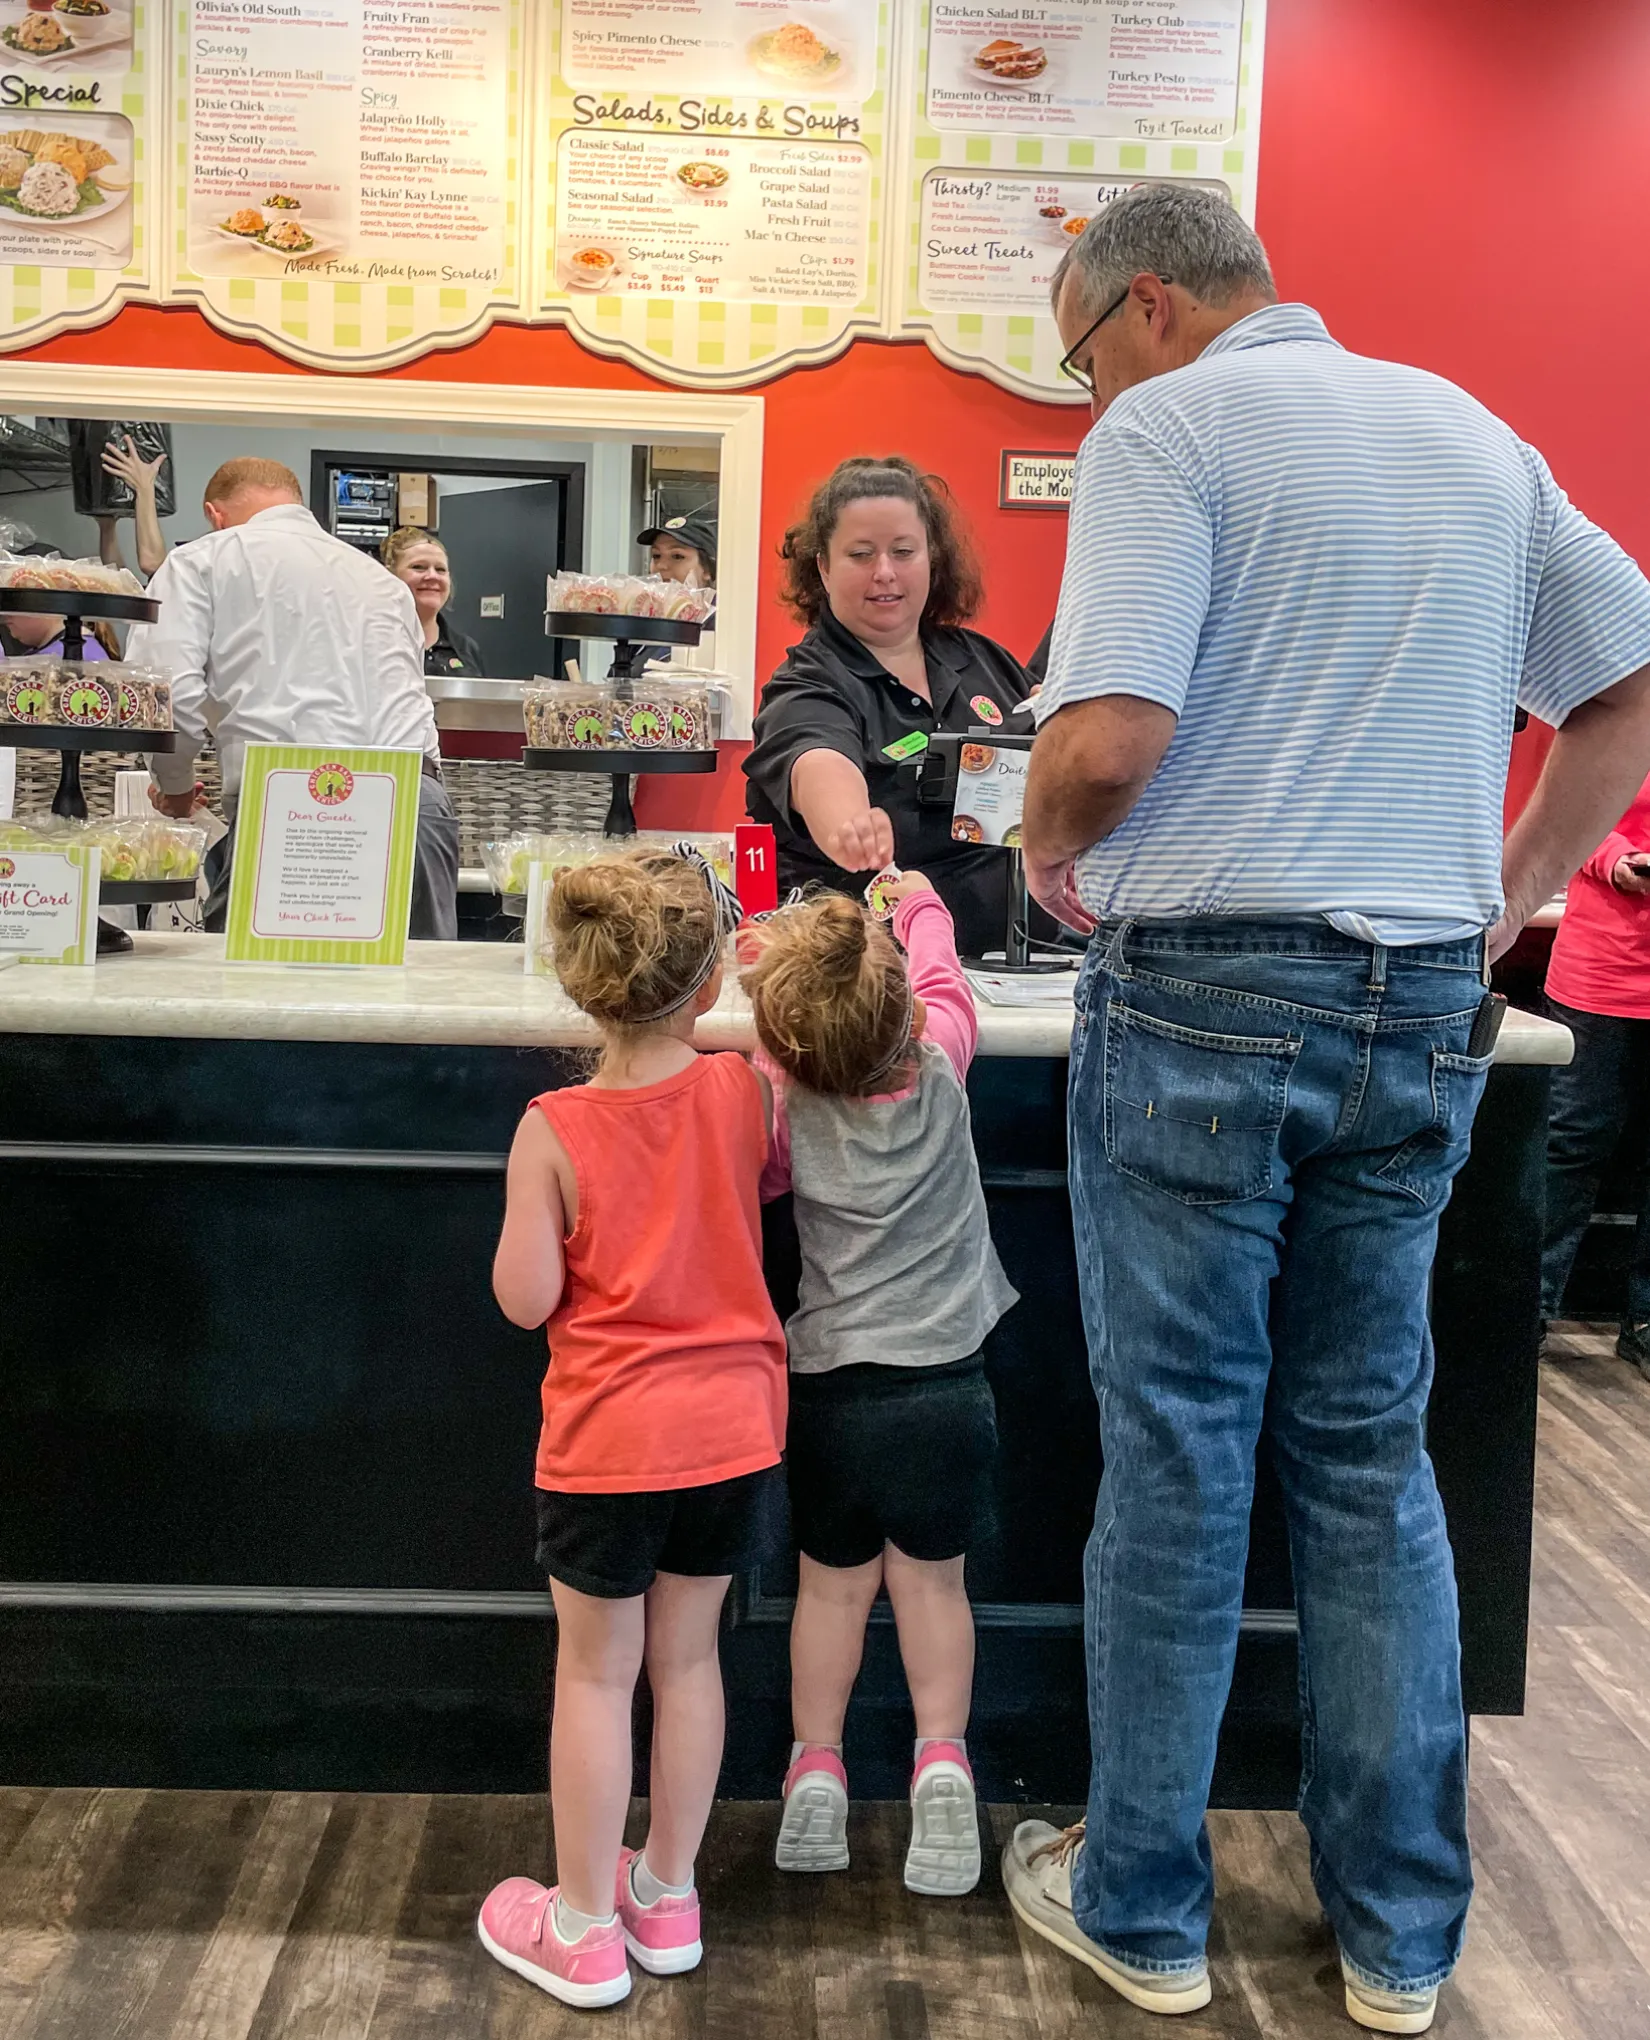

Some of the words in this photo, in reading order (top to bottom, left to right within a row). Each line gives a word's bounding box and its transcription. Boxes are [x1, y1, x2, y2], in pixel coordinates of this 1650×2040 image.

[195, 1, 239, 12] Olivia's
[242, 3, 265, 14] Old
[267, 4, 301, 16] South
[936, 5, 984, 18] Chicken
[986, 8, 1018, 20] Salad
[1021, 9, 1048, 20] BLT
[363, 10, 399, 24] Fruity
[402, 12, 430, 24] Fran
[1111, 13, 1154, 27] Turkey
[1156, 15, 1184, 27] Club
[572, 29, 604, 44] Spicy
[607, 31, 657, 45] Pimento
[660, 34, 702, 47] Cheese
[195, 38, 248, 61] Savory
[362, 46, 423, 60] Cranberry
[426, 48, 453, 60] Kelli
[195, 64, 247, 78] Lauryn's
[250, 67, 292, 79] Lemon
[295, 69, 324, 81] Basil
[1108, 70, 1152, 84] Turkey
[1154, 72, 1186, 84] Pesto
[0, 74, 102, 107] Special
[361, 86, 397, 107] Spicy
[932, 88, 981, 101] Pimento
[984, 91, 1025, 103] Cheese
[1028, 93, 1055, 104] BLT
[195, 98, 228, 110] Dixie
[230, 100, 265, 112] Chick
[359, 112, 412, 126] Jalapeño
[415, 114, 447, 127] Holly
[572, 94, 672, 126] Salads,
[679, 100, 748, 130] Sides
[755, 105, 775, 129] &
[783, 105, 860, 139] Soups
[195, 120, 209, 128] The
[212, 121, 230, 130] only
[250, 123, 267, 131] with
[1134, 118, 1155, 136] Try
[1158, 122, 1167, 134] it
[1170, 120, 1223, 136] Toasted!
[194, 132, 227, 145] Sassy
[229, 133, 266, 148] Scotty
[569, 138, 610, 151] Classic
[612, 140, 645, 152] Salad
[361, 150, 402, 163] Buffalo
[405, 152, 449, 166] Barclay
[837, 154, 863, 164] $2.99
[195, 164, 248, 179] Barbie-Q
[750, 163, 797, 176] Broccoli
[799, 166, 831, 178] Salad
[203, 178, 233, 188] hickory
[235, 180, 267, 188] smoked
[269, 181, 288, 189] BBQ
[290, 182, 313, 190] flavor
[315, 183, 331, 191] that
[760, 180, 796, 194] Grape
[798, 182, 830, 194] Salad
[930, 177, 992, 200] Thirsty?
[996, 184, 1031, 192] Medium
[1036, 186, 1059, 194] $1.99
[361, 187, 402, 199] Kickin'
[404, 188, 428, 202] Kay
[431, 190, 468, 203] Lynne
[567, 189, 619, 201] Seasonal
[621, 191, 654, 204] Salad
[996, 194, 1021, 203] Large
[762, 196, 794, 209] Pasta
[796, 199, 828, 210] Salad
[932, 201, 950, 209] Iced
[767, 213, 800, 226] Fresh
[802, 215, 831, 227] Fruit
[931, 212, 954, 221] Fresh
[955, 214, 1001, 223] Lemonades
[744, 229, 769, 240] Mac
[785, 231, 826, 243] Cheese
[931, 224, 951, 232] Coca
[953, 225, 971, 233] Cola
[973, 226, 1009, 235] Products
[18, 235, 41, 245] plate
[42, 236, 61, 245] with
[63, 237, 83, 247] your
[37, 247, 59, 256] sides
[61, 248, 71, 256] or
[73, 248, 97, 259] soup!
[628, 246, 685, 262] Signature
[688, 249, 723, 264] Soups
[926, 239, 979, 258] Sweet
[983, 241, 1035, 260] Treats
[800, 253, 828, 267] Chips
[832, 257, 855, 265] $1.79
[929, 262, 978, 271] Buttercream
[980, 264, 1011, 272] Frosted
[284, 258, 320, 275] Made
[368, 262, 404, 278] Made
[407, 265, 437, 280] from
[441, 265, 498, 281] Scratch!
[928, 271, 956, 280] Flower
[957, 273, 985, 281] Cookie
[631, 272, 650, 281] Cup
[662, 274, 684, 282] Bowl
[695, 275, 719, 285] Quart
[627, 282, 652, 291] $3.49
[660, 284, 686, 293] $5.49
[699, 286, 713, 294] $13
[1012, 462, 1075, 483] Employe
[1019, 481, 1042, 496] the
[9, 681, 35, 706] CHICKEN
[62, 682, 90, 709] CHICKEN
[92, 683, 109, 711] SALAD
[124, 688, 137, 712] SALAD
[17, 712, 39, 724] CHIC
[71, 715, 99, 725] CHICK
[568, 709, 592, 736] CHICKEN
[624, 704, 648, 731] CHICKEN
[650, 704, 665, 732] SALAD
[676, 706, 693, 732] SALAD
[634, 736, 658, 745] CHICK
[998, 762, 1026, 775] Dail
[308, 763, 337, 790] CHICKEN
[338, 765, 353, 791] SALAD
[316, 795, 344, 805] CHICK
[288, 810, 313, 822] Dear
[744, 846, 765, 873] 11
[0, 890, 20, 909] ift
[23, 889, 73, 908] Card
[4, 909, 25, 917] Grand
[27, 909, 58, 918] Opening!
[279, 911, 300, 922] Your
